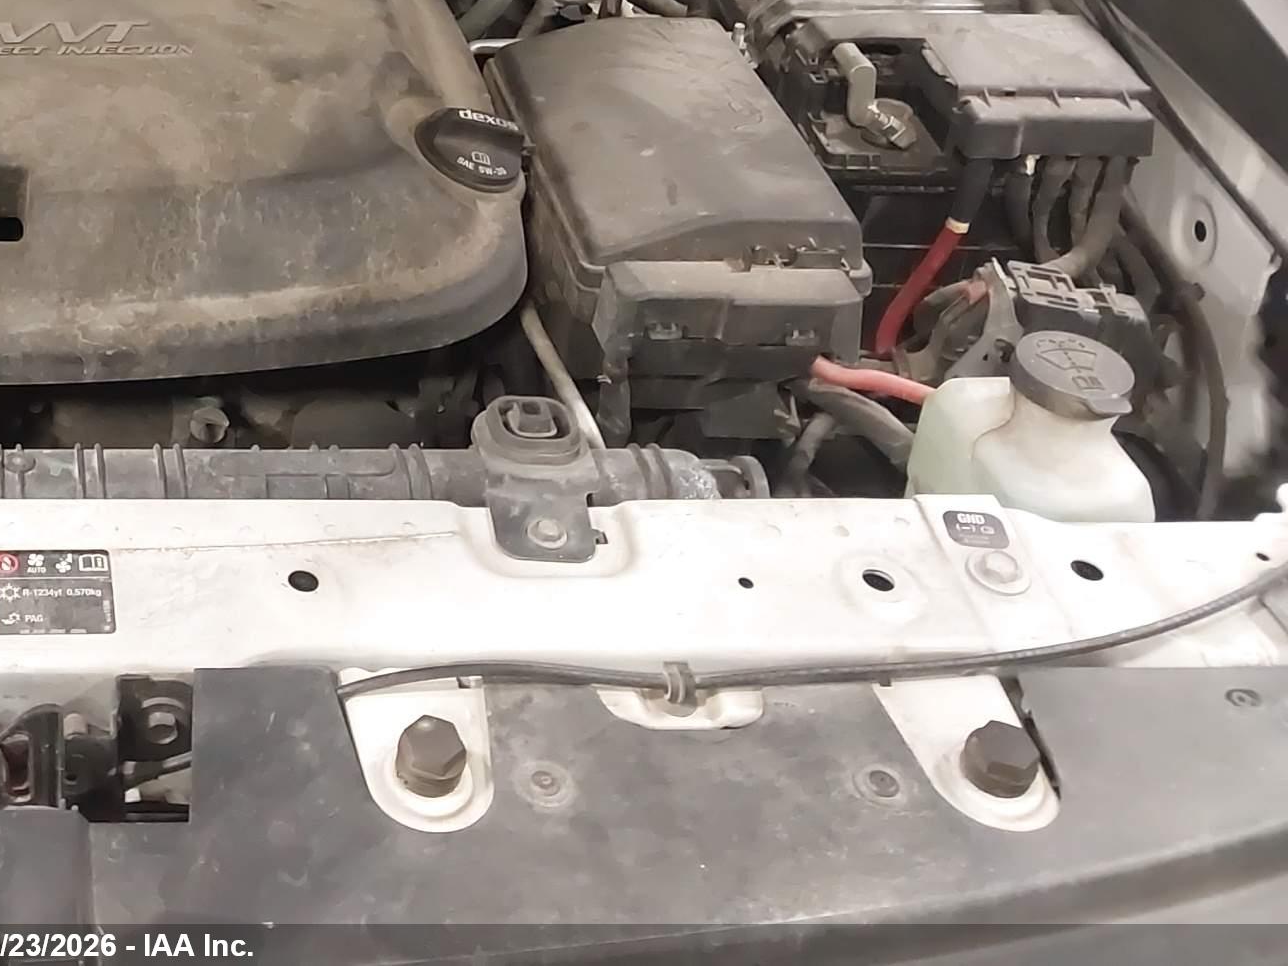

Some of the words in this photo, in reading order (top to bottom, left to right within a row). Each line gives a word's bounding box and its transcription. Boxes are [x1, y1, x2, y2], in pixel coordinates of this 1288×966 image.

[56, 43, 195, 59] INJECTION
[456, 156, 475, 170] SAE
[26, 566, 47, 574] AUTO
[22, 588, 63, 598] R-1234yf
[66, 588, 103, 598] 0.570kg
[24, 614, 44, 623] PAG
